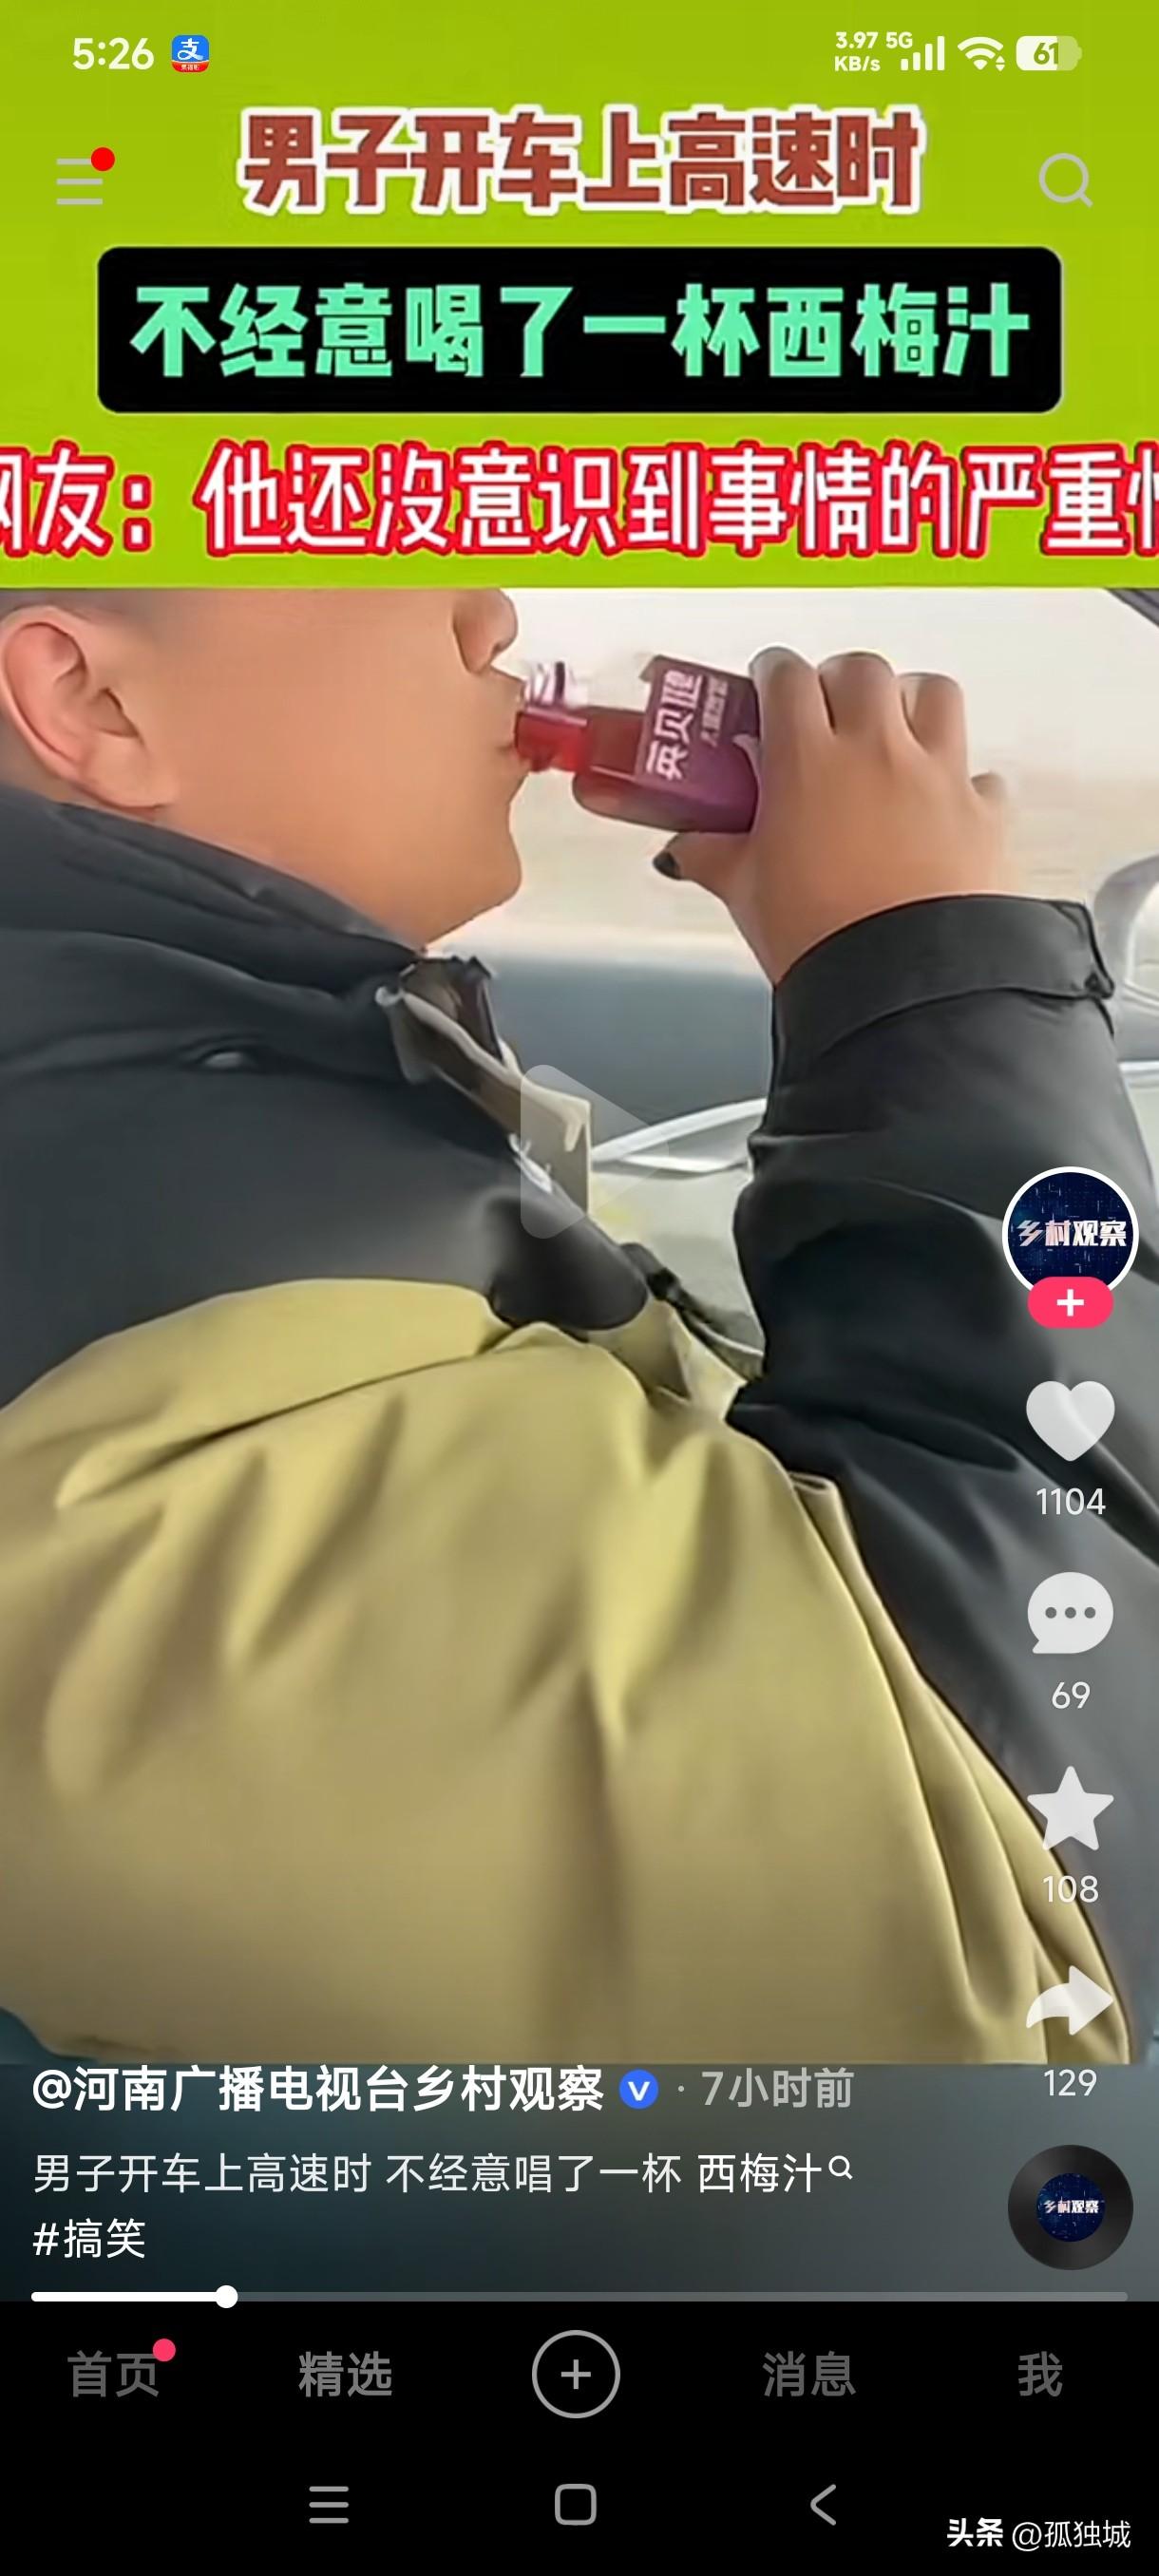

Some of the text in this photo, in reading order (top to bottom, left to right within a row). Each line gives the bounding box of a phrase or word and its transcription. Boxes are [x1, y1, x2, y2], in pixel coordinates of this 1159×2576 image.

[72, 37, 155, 70] 5:26
[835, 31, 913, 49] 3.97 5G
[1033, 42, 1059, 66] 61
[834, 55, 881, 72] KB/s
[1016, 1219, 1128, 1247] 乡村观察
[1036, 1487, 1106, 1516] 1104
[1052, 1681, 1092, 1709] 69
[1042, 1875, 1099, 1903] 108
[32, 2064, 605, 2112] @河南广播电视台乡村观察
[701, 2066, 855, 2109] 7小时前
[1043, 2069, 1098, 2097] 129
[34, 2152, 822, 2193] 男子开车上高速时 不经意唱了一杯 西梅汁
[1043, 2199, 1099, 2214] 乡村观察
[32, 2218, 145, 2259] #搞笑
[66, 2350, 162, 2397] 首页
[297, 2350, 392, 2397] 精选
[762, 2350, 857, 2397] 消息
[1017, 2351, 1063, 2397] 我
